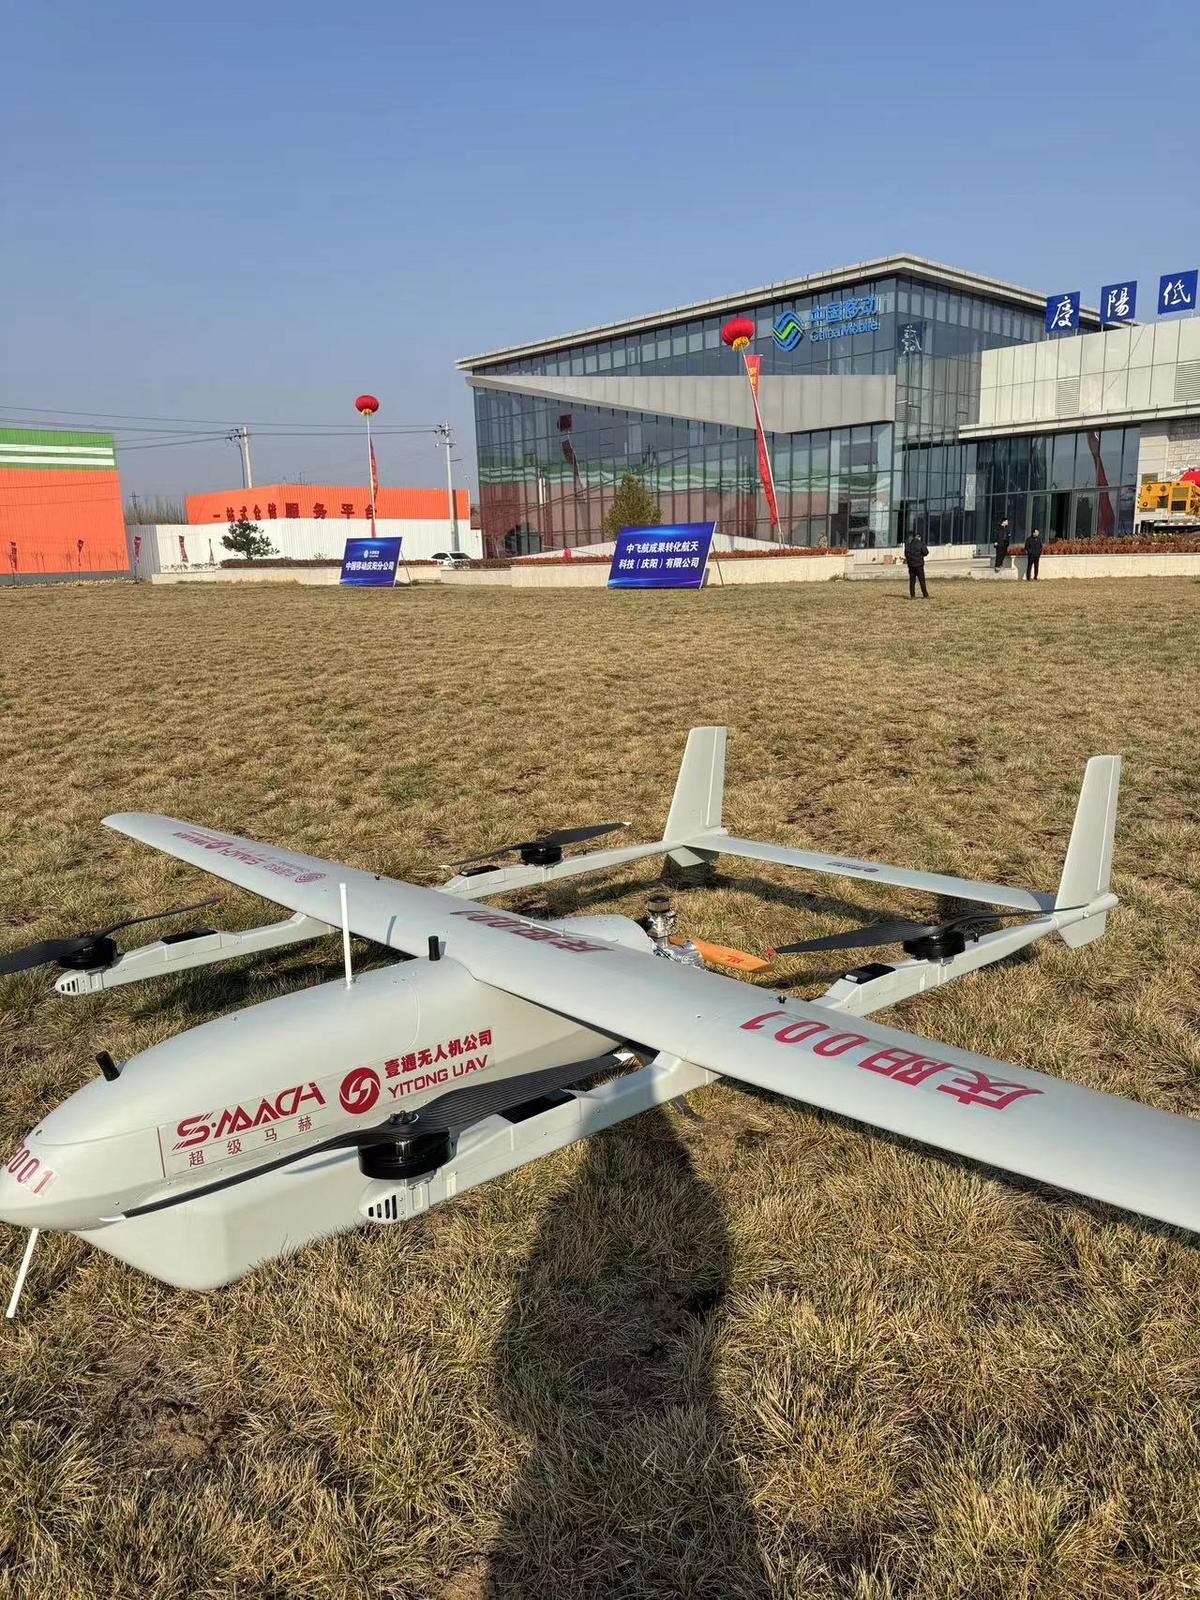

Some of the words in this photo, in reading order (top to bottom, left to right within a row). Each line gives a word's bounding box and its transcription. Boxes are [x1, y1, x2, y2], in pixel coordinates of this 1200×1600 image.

[810, 295, 881, 323] 中国移动
[626, 541, 699, 554] 中飞航成果转化航天
[346, 561, 394, 571] 中国移动庆阳分公司
[385, 1029, 492, 1079] 壹通无人机公司
[388, 1068, 449, 1099] YITONG
[452, 1054, 488, 1077] UAV
[188, 1115, 313, 1168] 超级马赫
